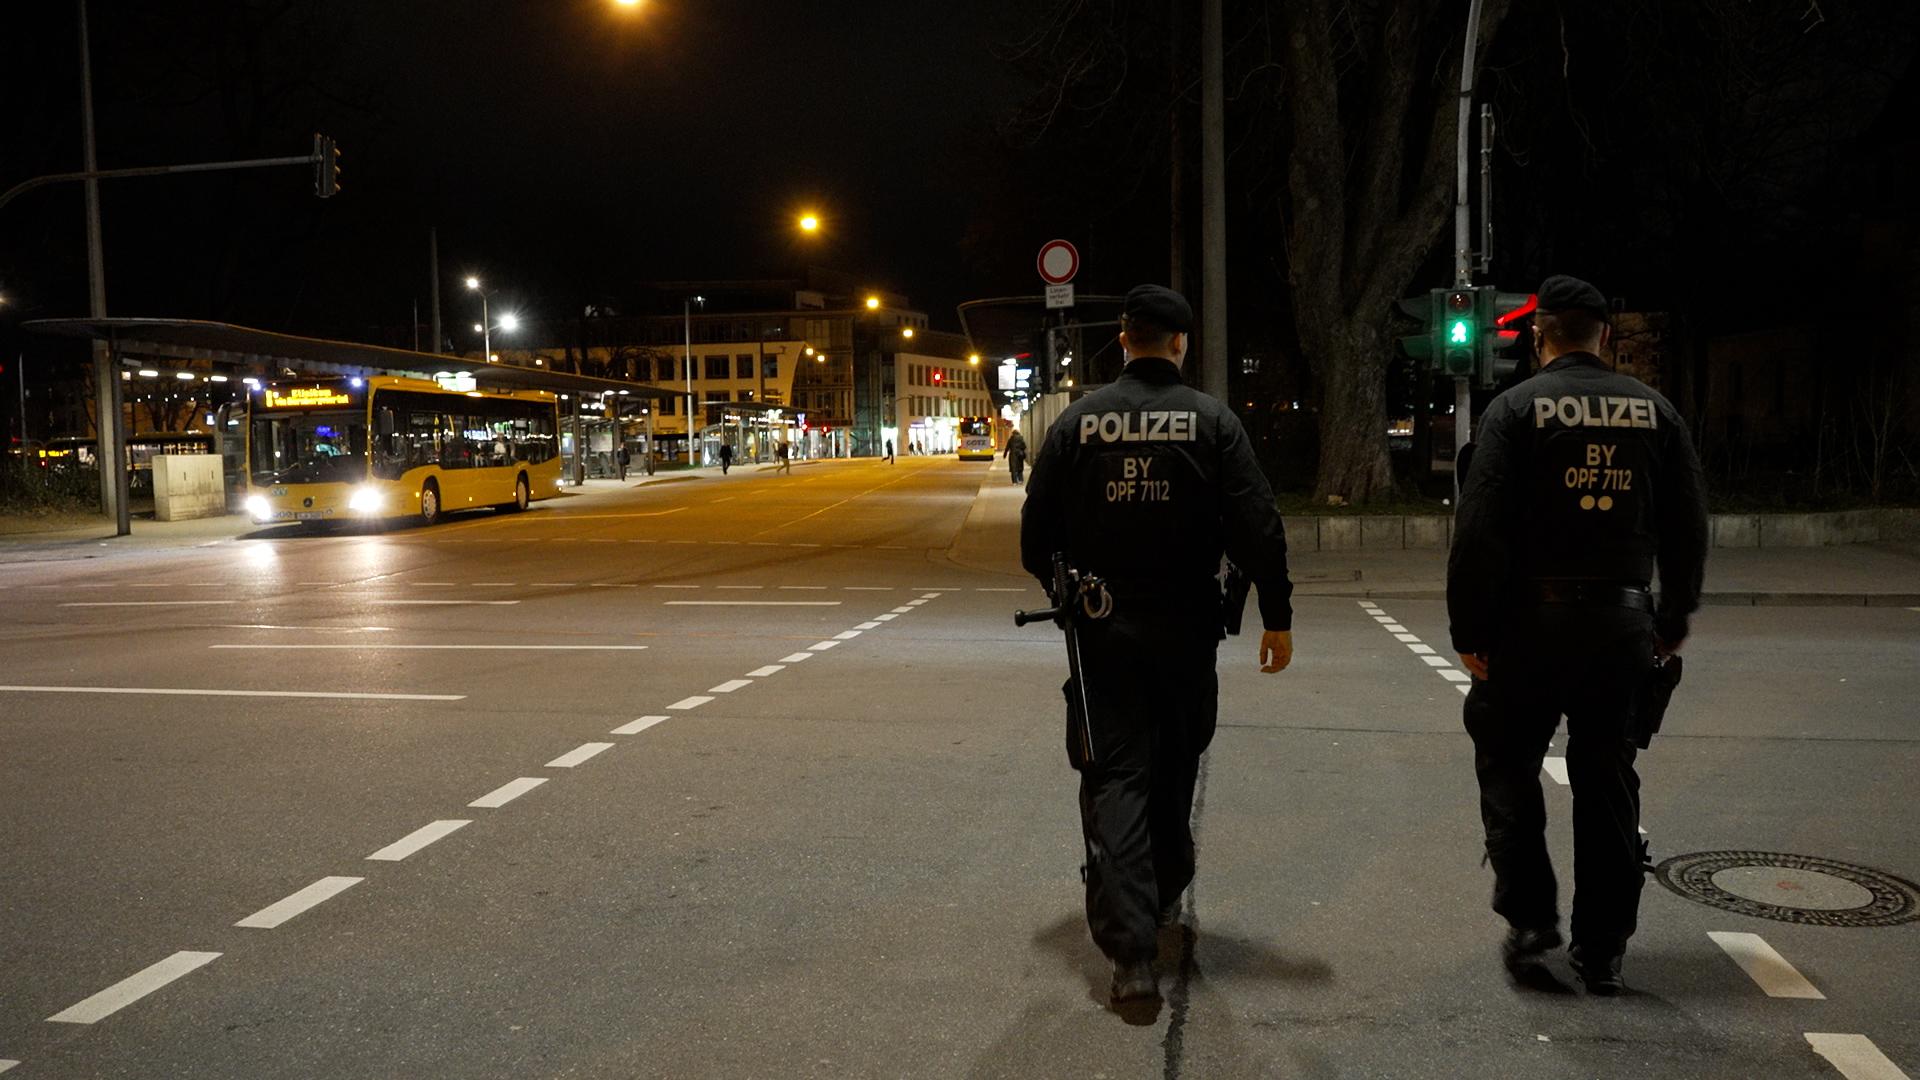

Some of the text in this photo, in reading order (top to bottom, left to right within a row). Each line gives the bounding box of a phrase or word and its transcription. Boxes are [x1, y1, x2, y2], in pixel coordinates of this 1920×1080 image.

[1533, 395, 1657, 430] POLIZEI
[1079, 411, 1197, 444] POLIZEI
[1586, 444, 1617, 466] BY
[1123, 457, 1153, 479] BY
[1565, 467, 1633, 490] OPF 7112
[1106, 480, 1170, 501] OPF 7112
